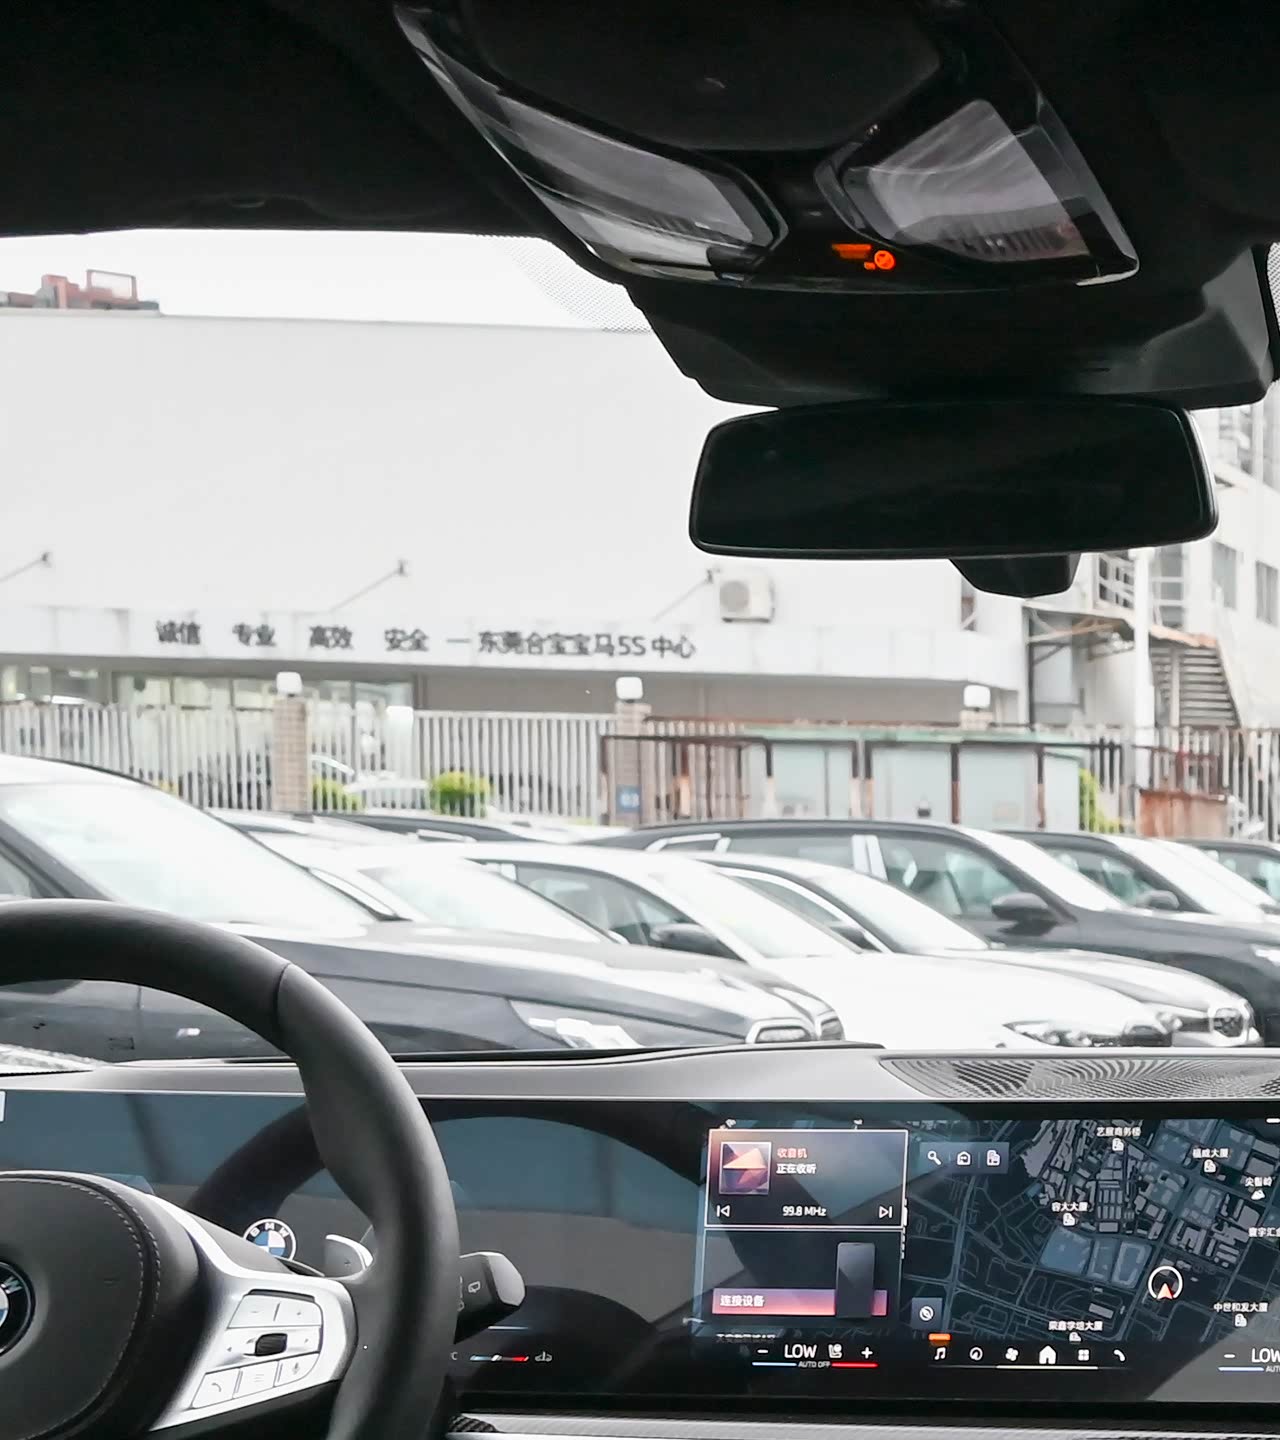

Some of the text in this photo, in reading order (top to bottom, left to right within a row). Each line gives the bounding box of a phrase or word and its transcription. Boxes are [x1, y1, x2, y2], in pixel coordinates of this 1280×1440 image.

[156, 620, 201, 645] 诚信
[232, 622, 277, 647] 专业
[309, 624, 353, 649] 高效
[384, 627, 429, 651] 安全
[777, 1147, 808, 1159] 收音机
[776, 1163, 817, 1175] 正在收听
[782, 1206, 827, 1217] 99.8 MHz
[249, 1222, 290, 1238] BMW
[720, 1294, 765, 1307] 连接设备
[783, 1344, 818, 1358] LOW
[798, 1361, 831, 1369] AUTO OFF
